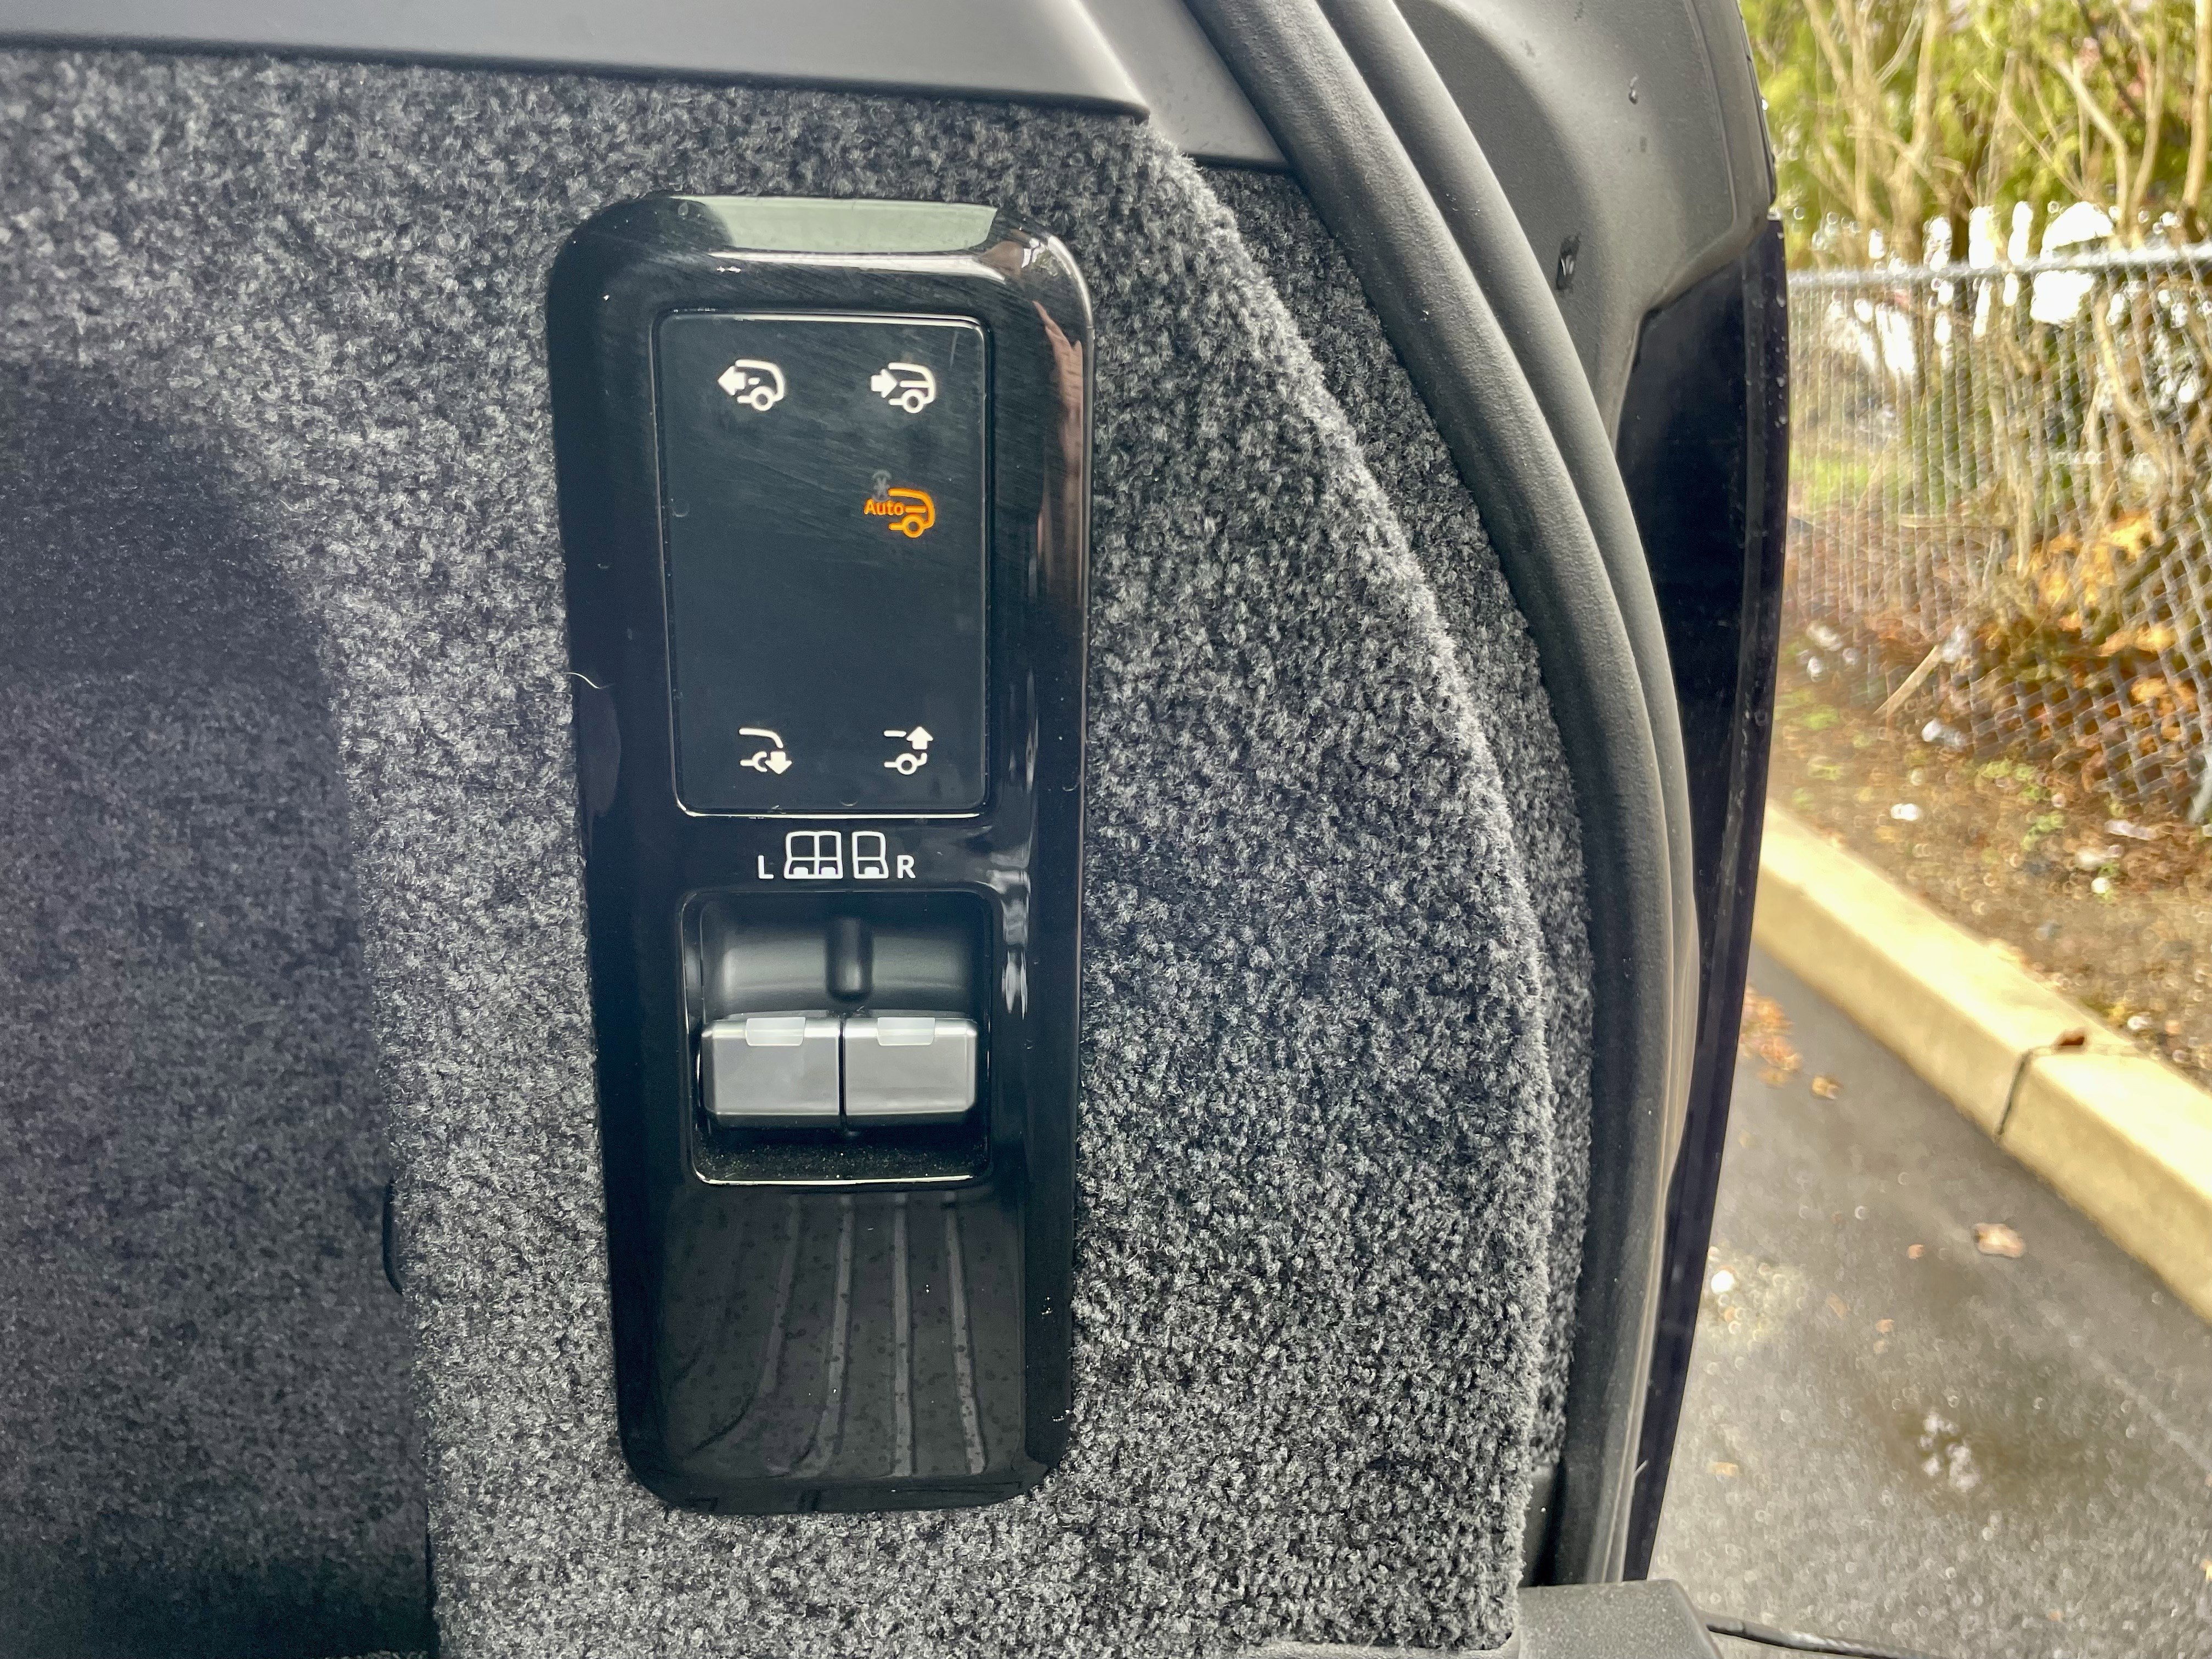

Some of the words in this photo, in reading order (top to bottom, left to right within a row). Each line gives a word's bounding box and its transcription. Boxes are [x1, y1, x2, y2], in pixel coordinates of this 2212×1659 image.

[864, 498, 904, 516] Auto
[758, 855, 774, 879] L
[897, 855, 916, 879] R
